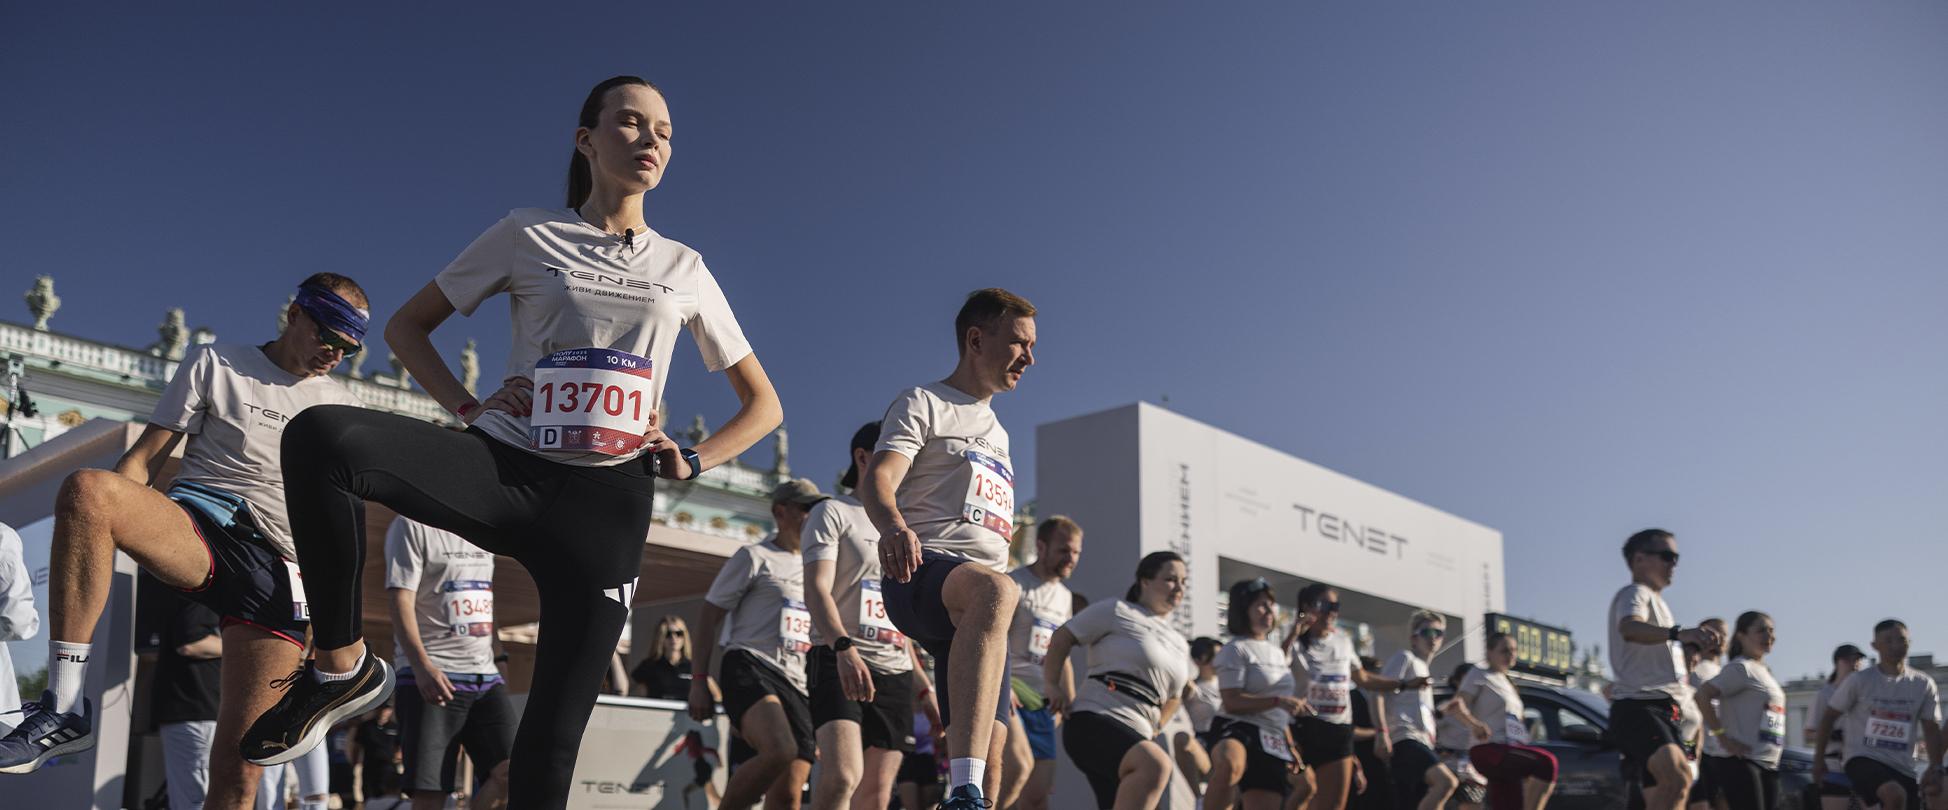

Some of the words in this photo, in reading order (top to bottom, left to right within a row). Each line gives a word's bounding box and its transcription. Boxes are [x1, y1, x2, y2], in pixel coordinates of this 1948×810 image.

[546, 267, 674, 294] TENET
[564, 284, 592, 294] ЖИВИ
[594, 289, 655, 304] ДВИЖЕНИЕМ
[606, 355, 619, 365] 10
[540, 382, 642, 422] 13701
[544, 428, 558, 446] D
[953, 435, 1008, 459] TENE
[1292, 503, 1408, 561] TENET
[451, 599, 494, 617] 1348
